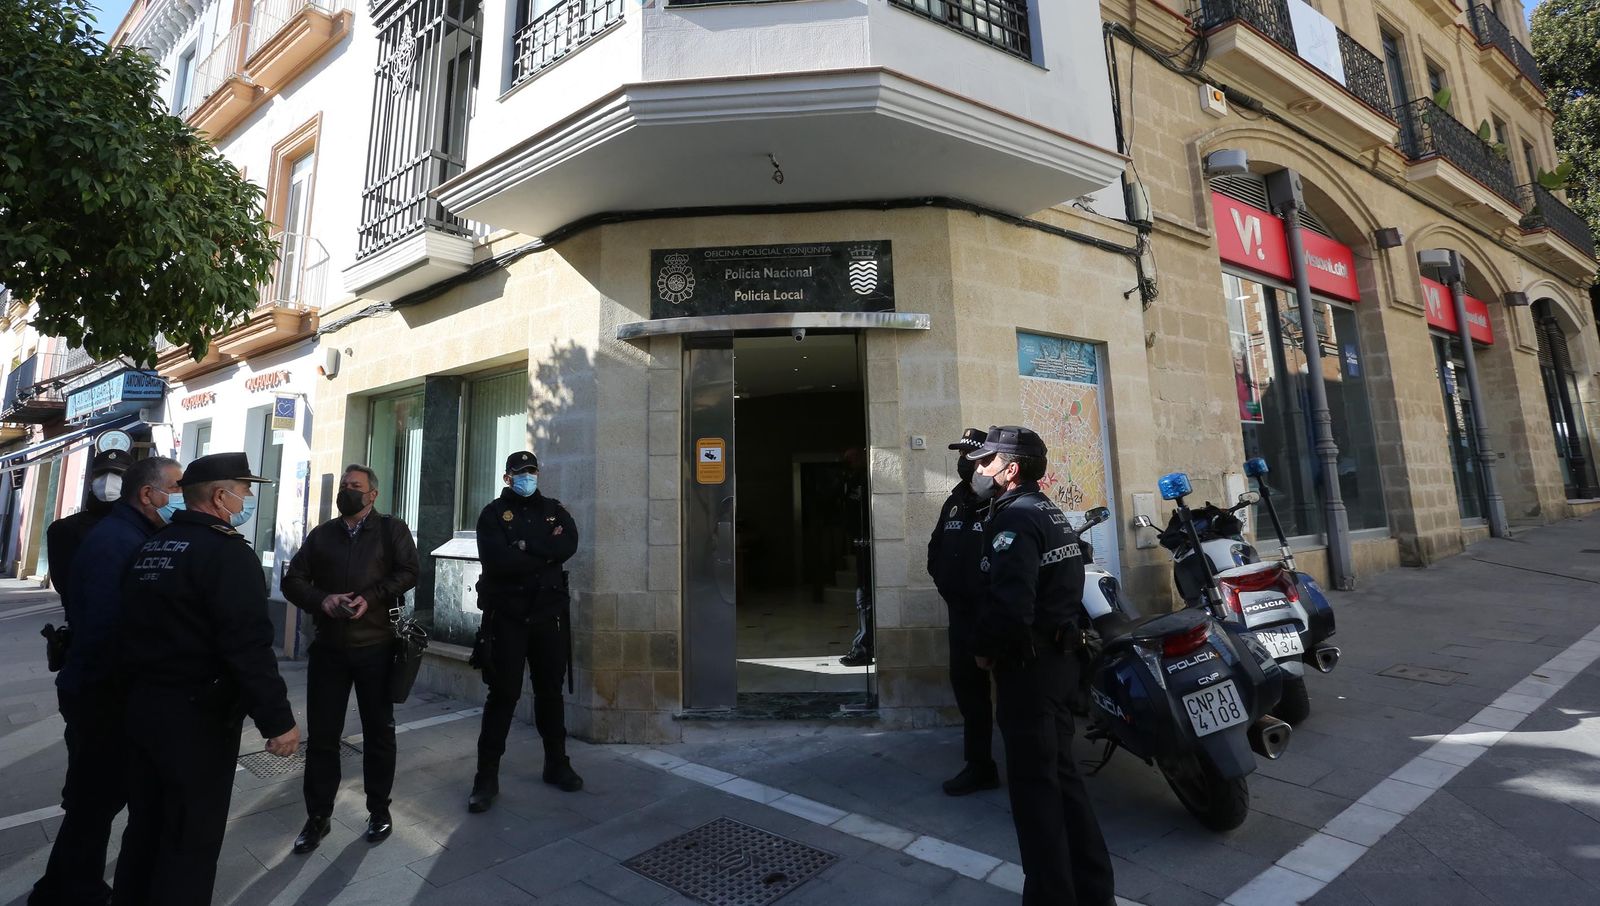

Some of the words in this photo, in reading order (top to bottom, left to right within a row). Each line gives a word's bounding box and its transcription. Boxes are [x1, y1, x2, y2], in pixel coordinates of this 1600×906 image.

[704, 249, 740, 258] OFICINA
[742, 248, 781, 256] POLICIAL
[783, 246, 832, 255] CONJUNTA
[763, 266, 813, 278] Nacional
[734, 289, 771, 301] Policía
[773, 288, 804, 300] Local
[140, 540, 190, 553] POLICIA
[134, 556, 174, 569] LOCAL
[1245, 599, 1286, 613] POLICIA
[1197, 671, 1221, 686] CNP
[1187, 691, 1215, 716] CNP
[1215, 684, 1234, 706] AT
[1198, 702, 1241, 730] 4108
